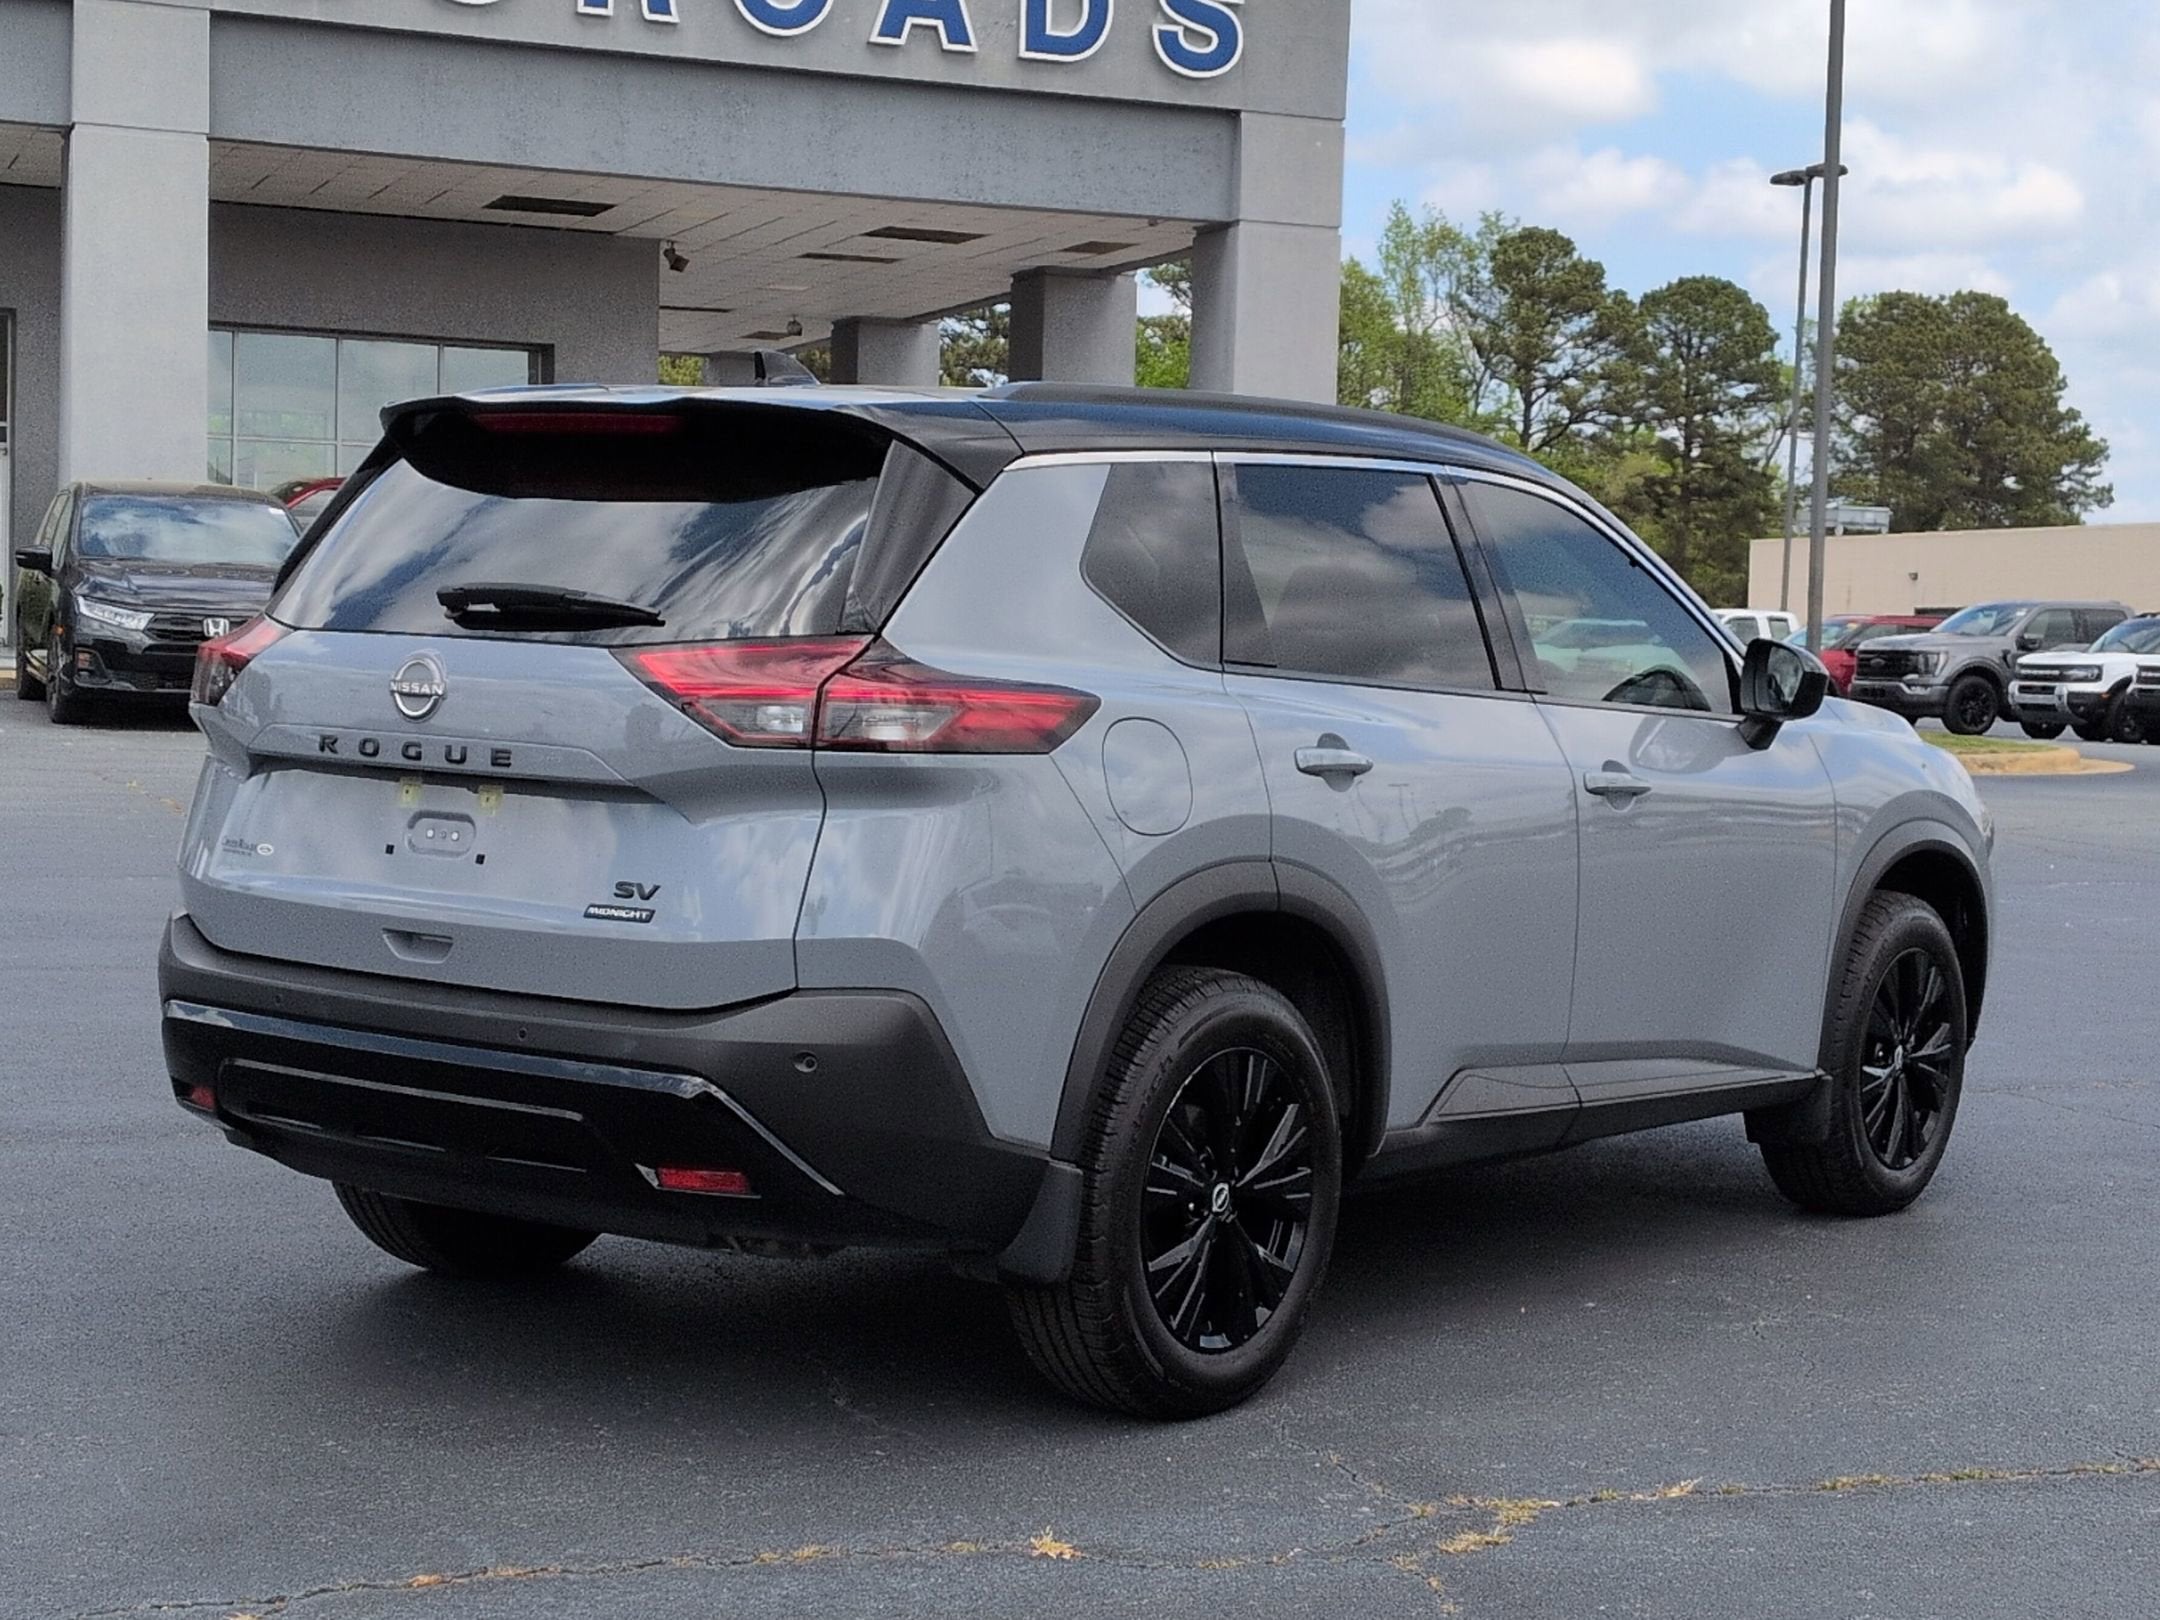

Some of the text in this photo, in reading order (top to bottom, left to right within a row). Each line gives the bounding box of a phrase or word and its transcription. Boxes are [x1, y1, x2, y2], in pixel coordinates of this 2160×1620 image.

[390, 680, 445, 696] NISSAN
[318, 734, 513, 768] ROGUE
[613, 880, 662, 901] SV
[585, 905, 652, 921] MIDNIGHT
